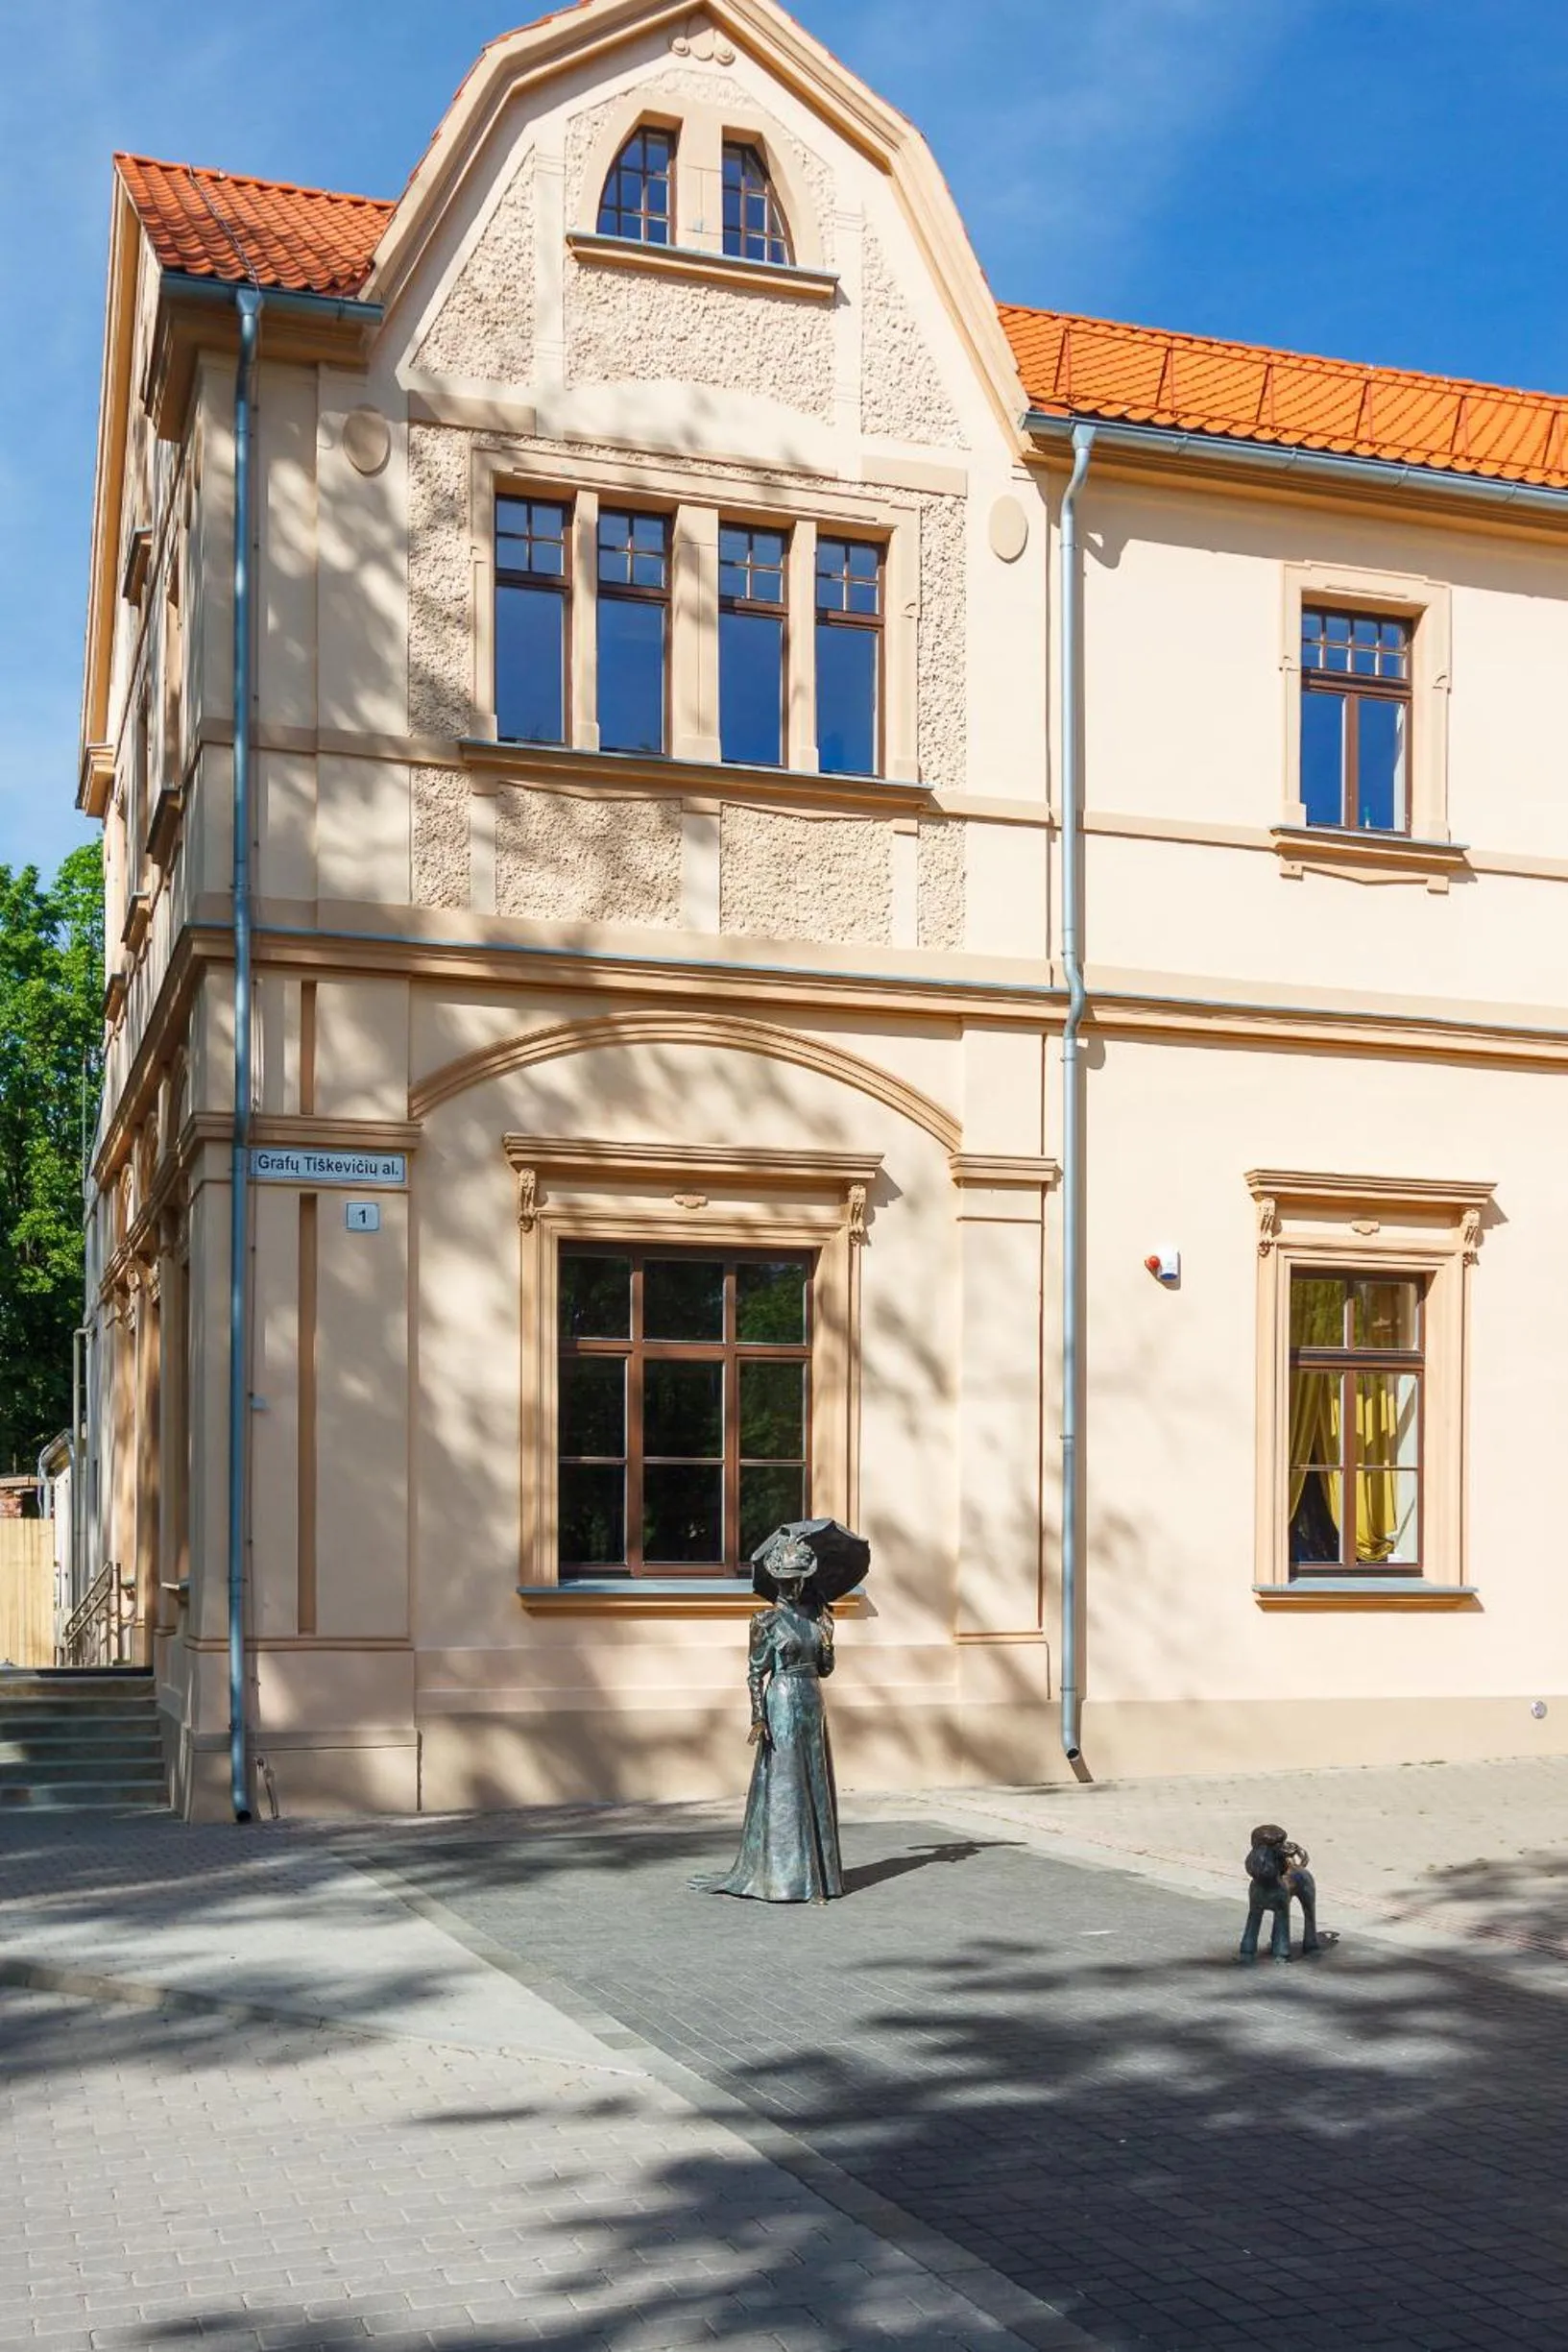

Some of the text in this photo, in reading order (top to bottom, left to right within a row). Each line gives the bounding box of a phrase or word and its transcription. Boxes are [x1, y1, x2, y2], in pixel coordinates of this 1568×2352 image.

[257, 1154, 399, 1176] Grafų Tiškevičių al.
[358, 1208, 367, 1224] 1
